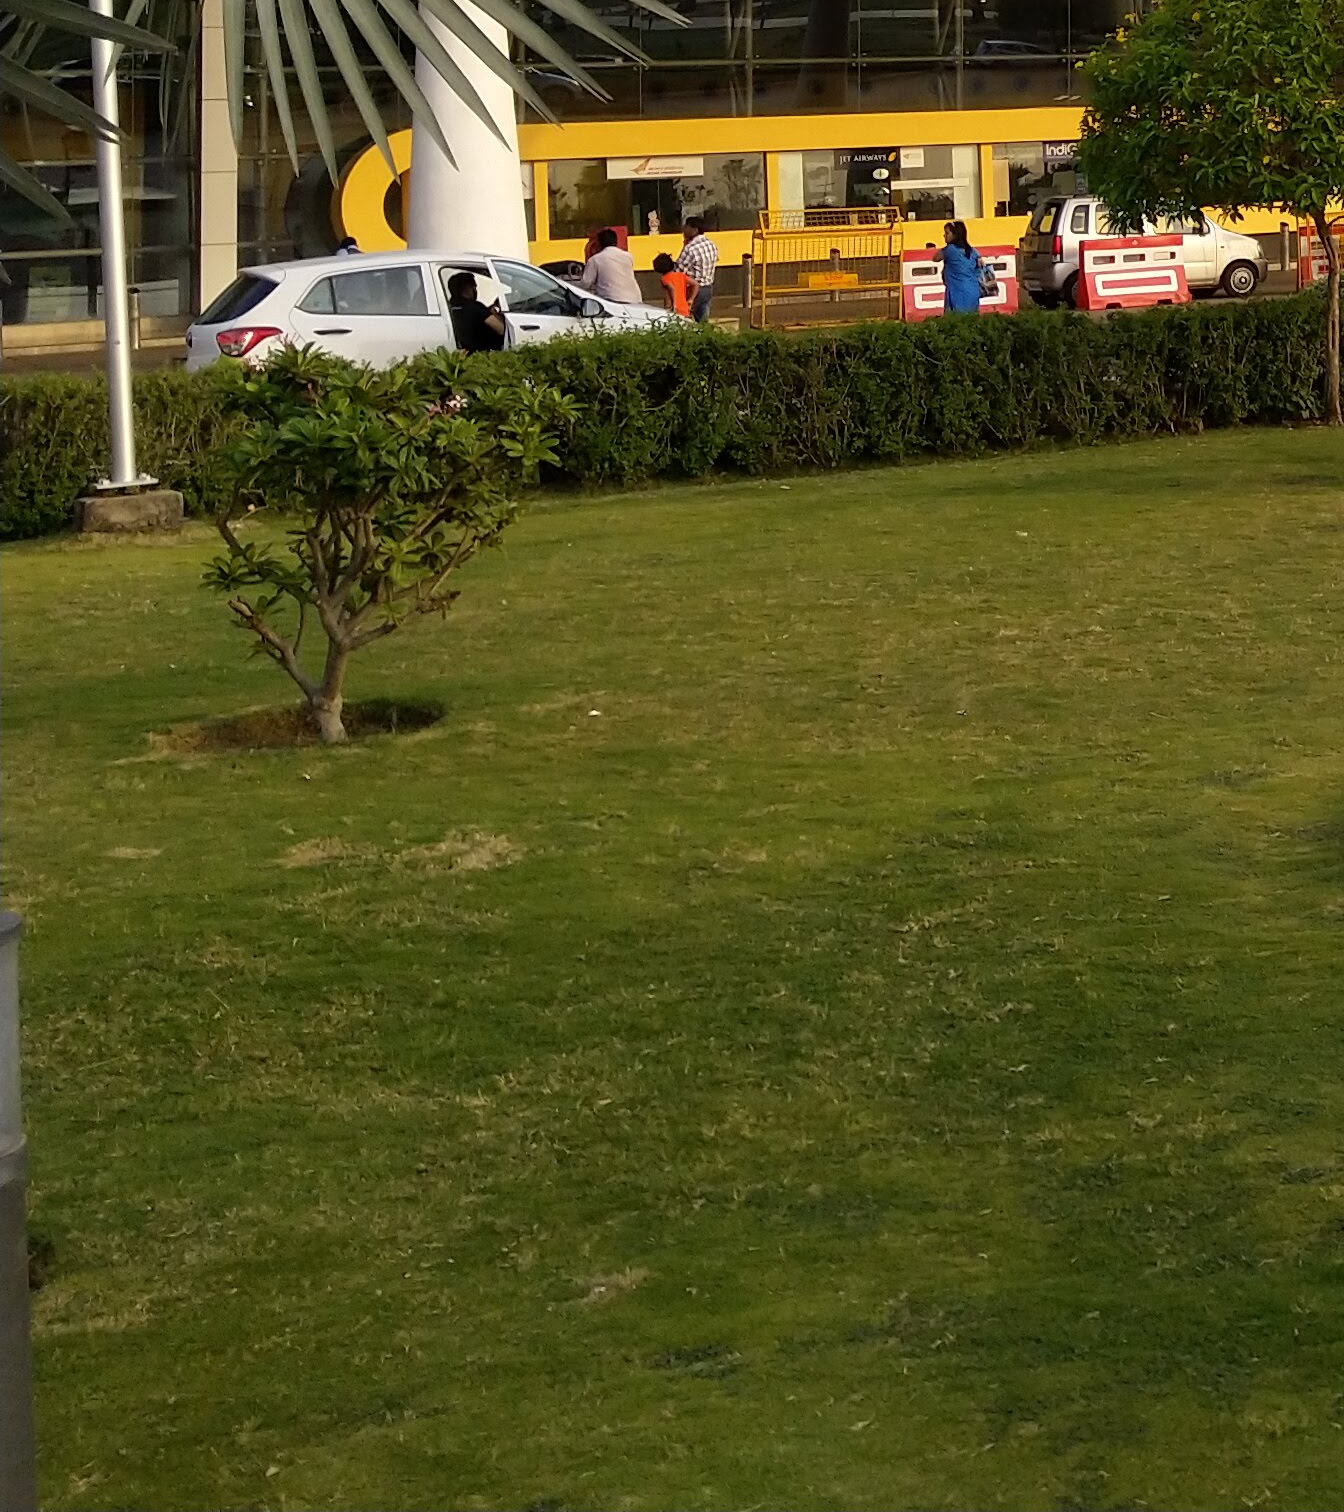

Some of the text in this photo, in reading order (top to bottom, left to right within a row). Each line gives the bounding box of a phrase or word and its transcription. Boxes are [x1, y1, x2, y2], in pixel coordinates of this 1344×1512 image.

[1046, 142, 1078, 156] IndiG
[839, 154, 887, 165] JET AIRWAYS
